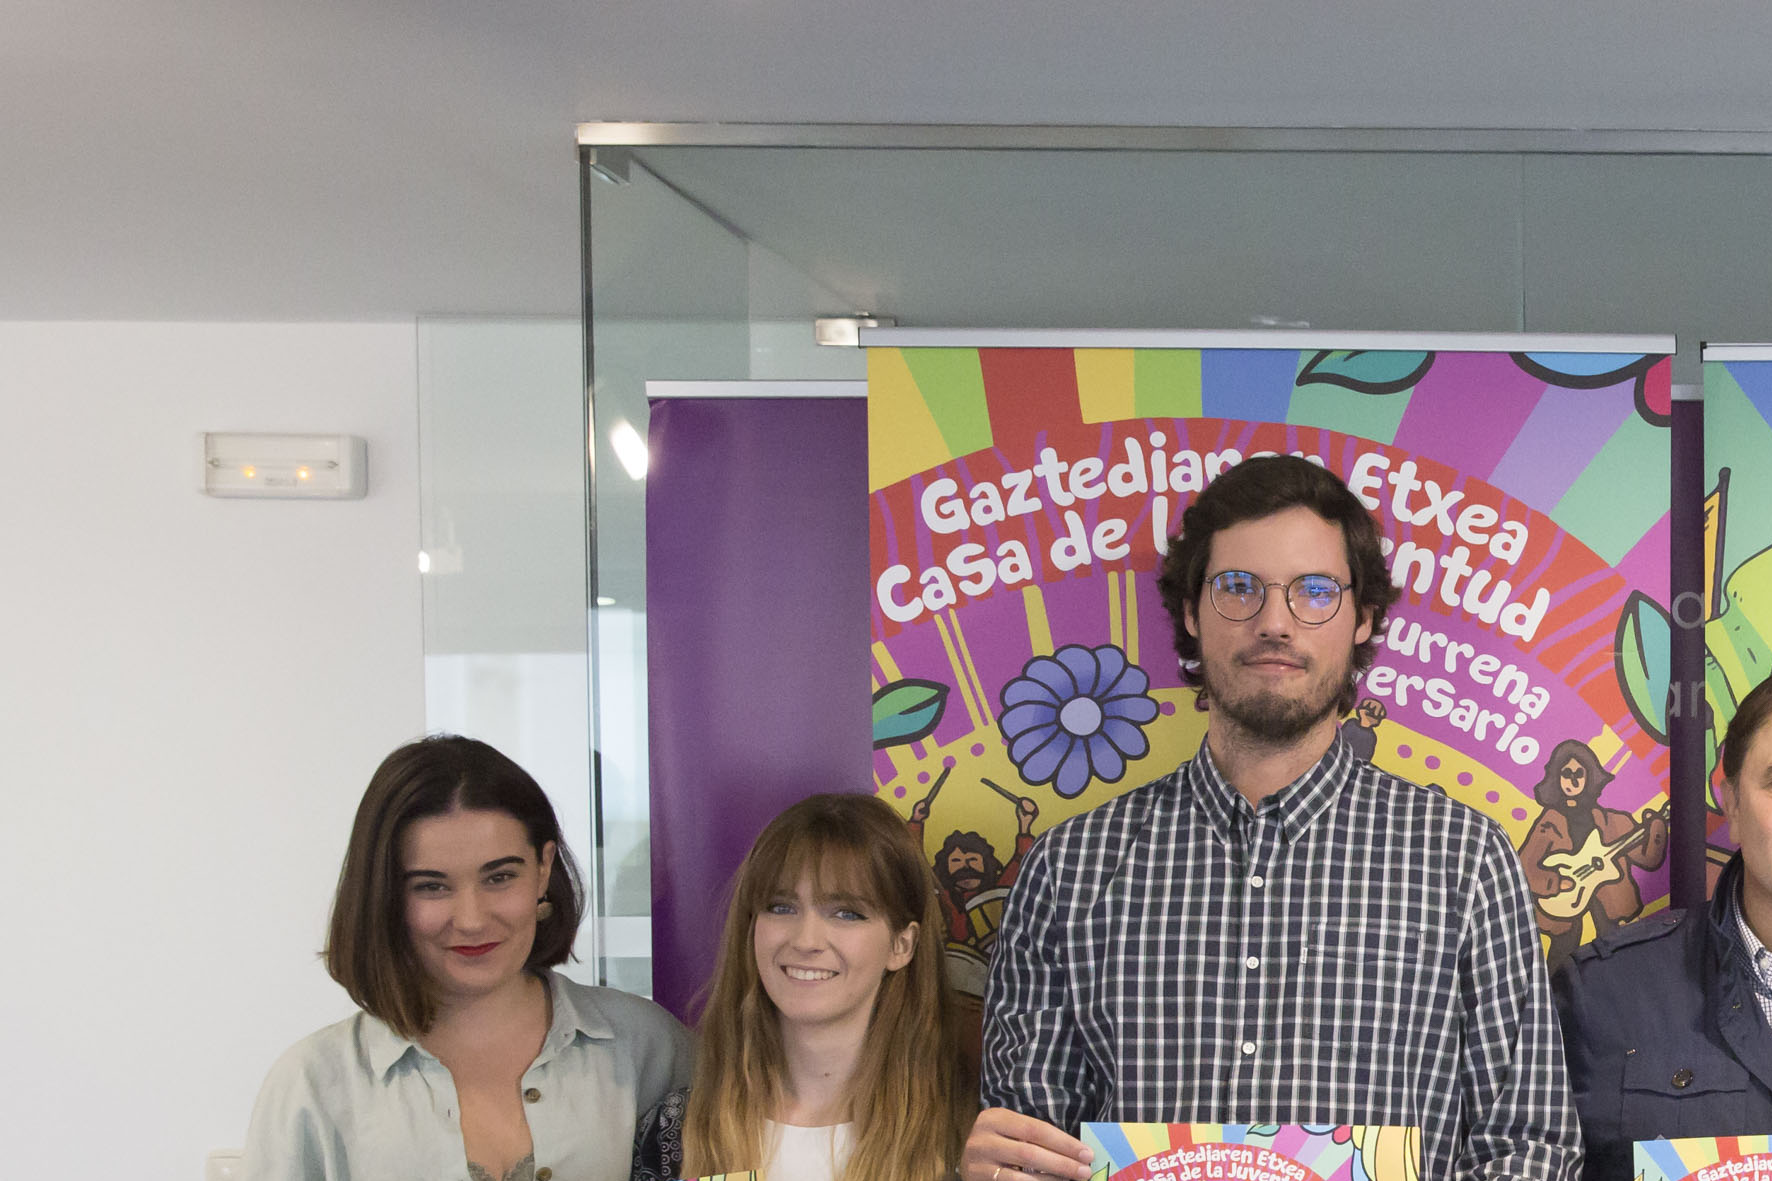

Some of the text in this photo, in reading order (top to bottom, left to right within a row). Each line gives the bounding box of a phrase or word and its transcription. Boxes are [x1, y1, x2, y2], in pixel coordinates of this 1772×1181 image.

[1348, 453, 1528, 565] Etxea
[877, 540, 1032, 622] Casa
[1053, 510, 1130, 571] de
[1146, 1144, 1305, 1181] Gaztediaren Etxea
[1180, 1164, 1202, 1181] de
[1206, 1160, 1223, 1178] la
